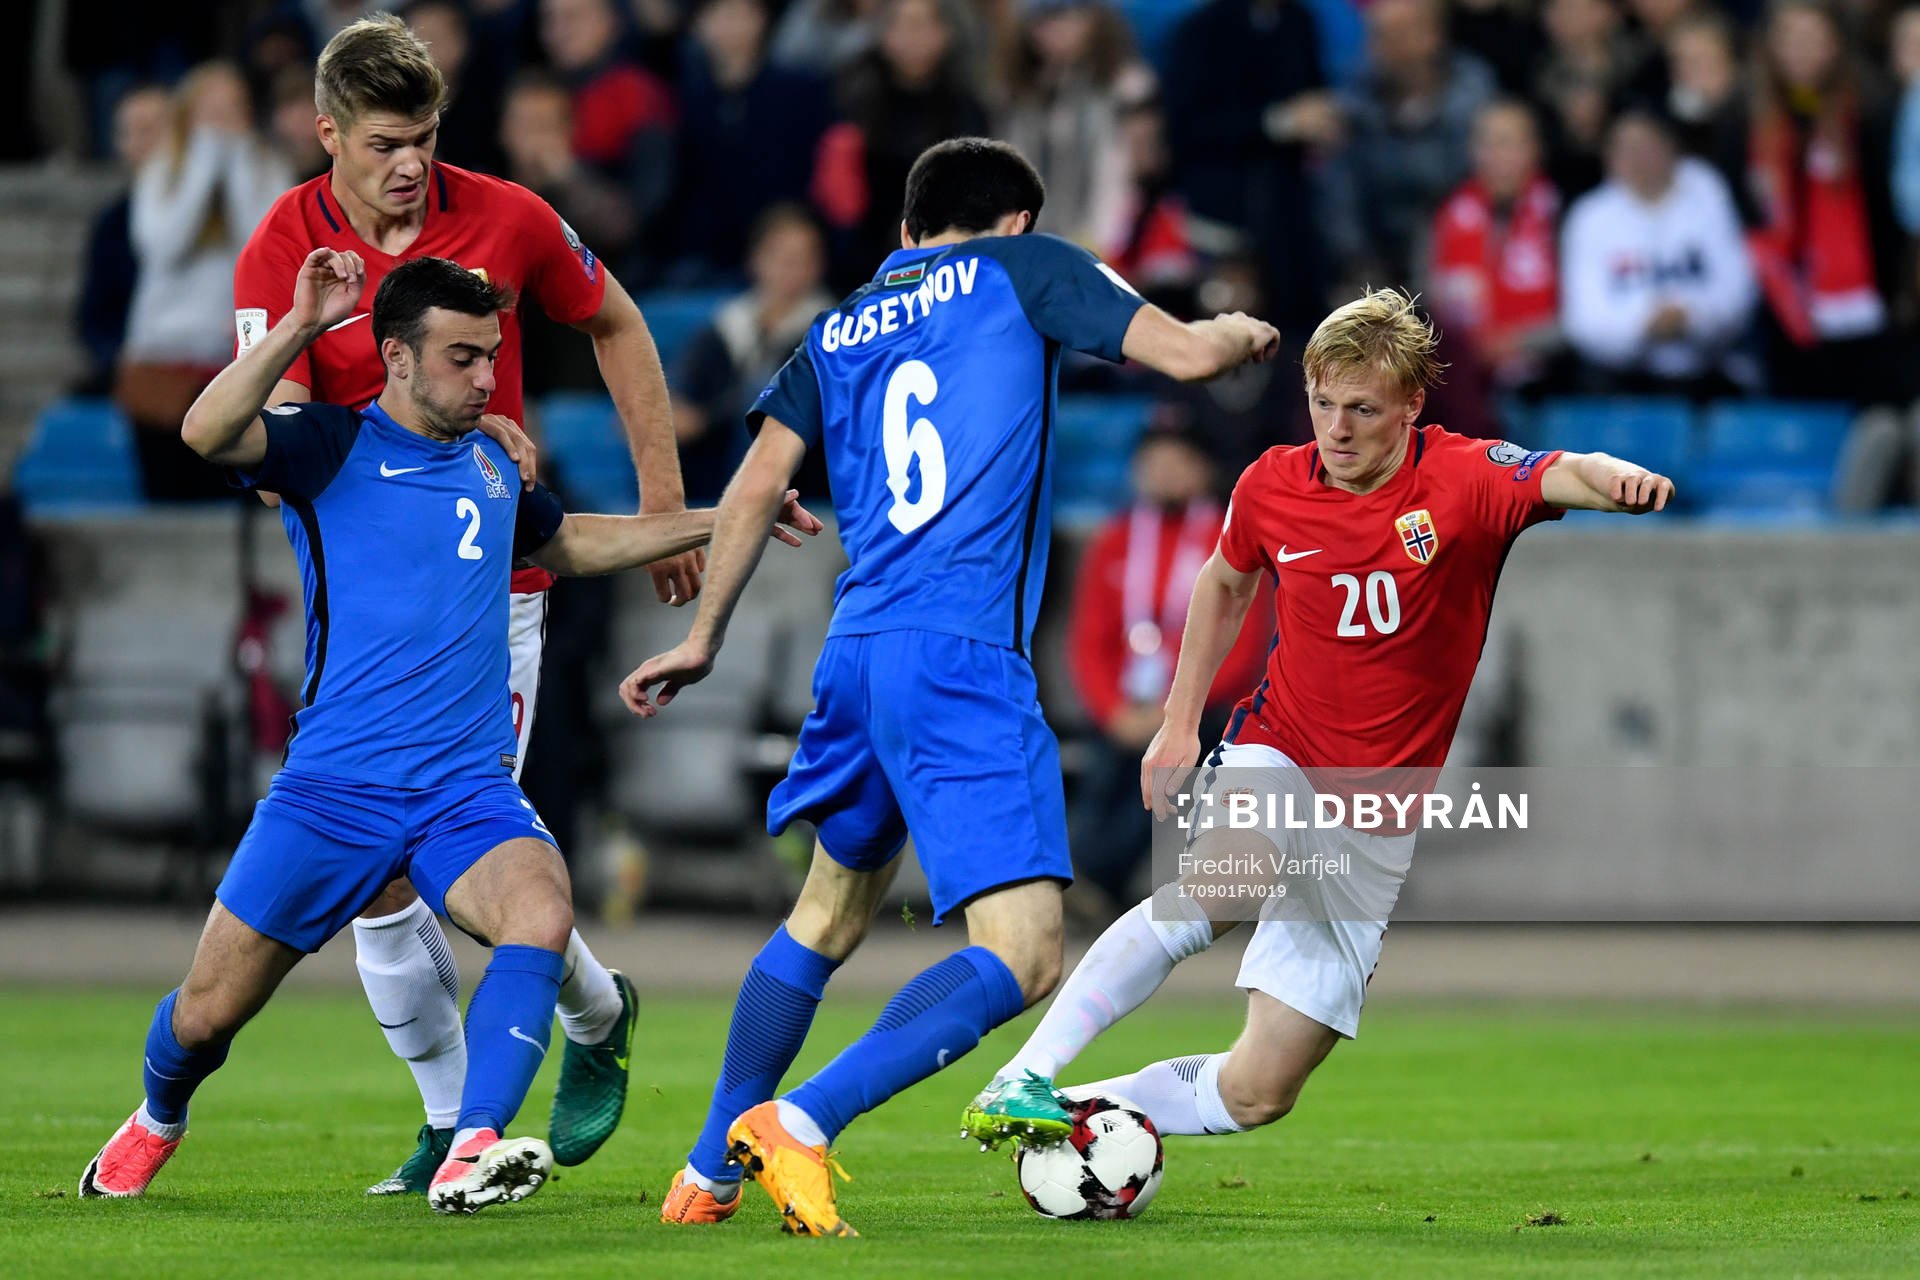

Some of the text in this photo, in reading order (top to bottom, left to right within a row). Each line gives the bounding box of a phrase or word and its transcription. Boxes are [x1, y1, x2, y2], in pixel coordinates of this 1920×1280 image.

[822, 257, 979, 353] GUSEYNOV
[883, 360, 947, 535] 6
[456, 497, 483, 560] 2
[1331, 570, 1401, 638] 20
